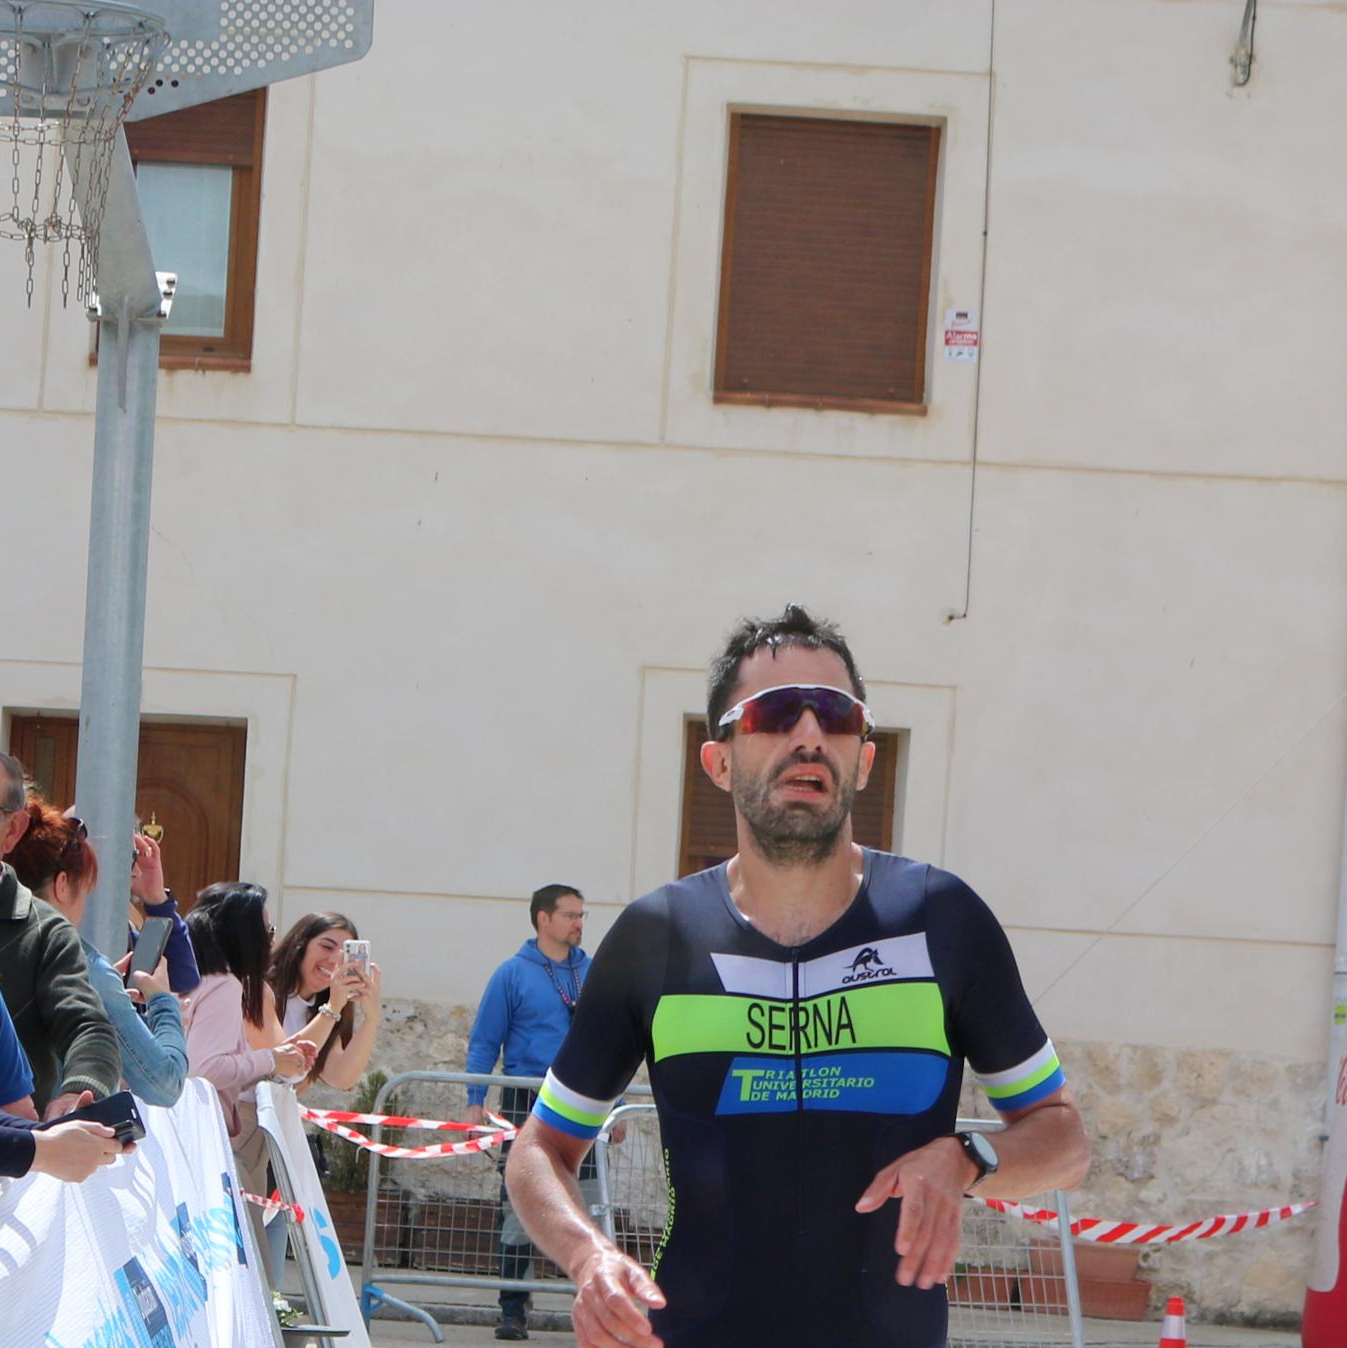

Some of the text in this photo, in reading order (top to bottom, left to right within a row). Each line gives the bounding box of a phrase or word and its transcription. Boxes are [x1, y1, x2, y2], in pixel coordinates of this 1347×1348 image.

[746, 996, 857, 1051] SERNA
[753, 1077, 876, 1091] UNIVERSITARIO
[751, 1088, 841, 1101] DE MADRID
